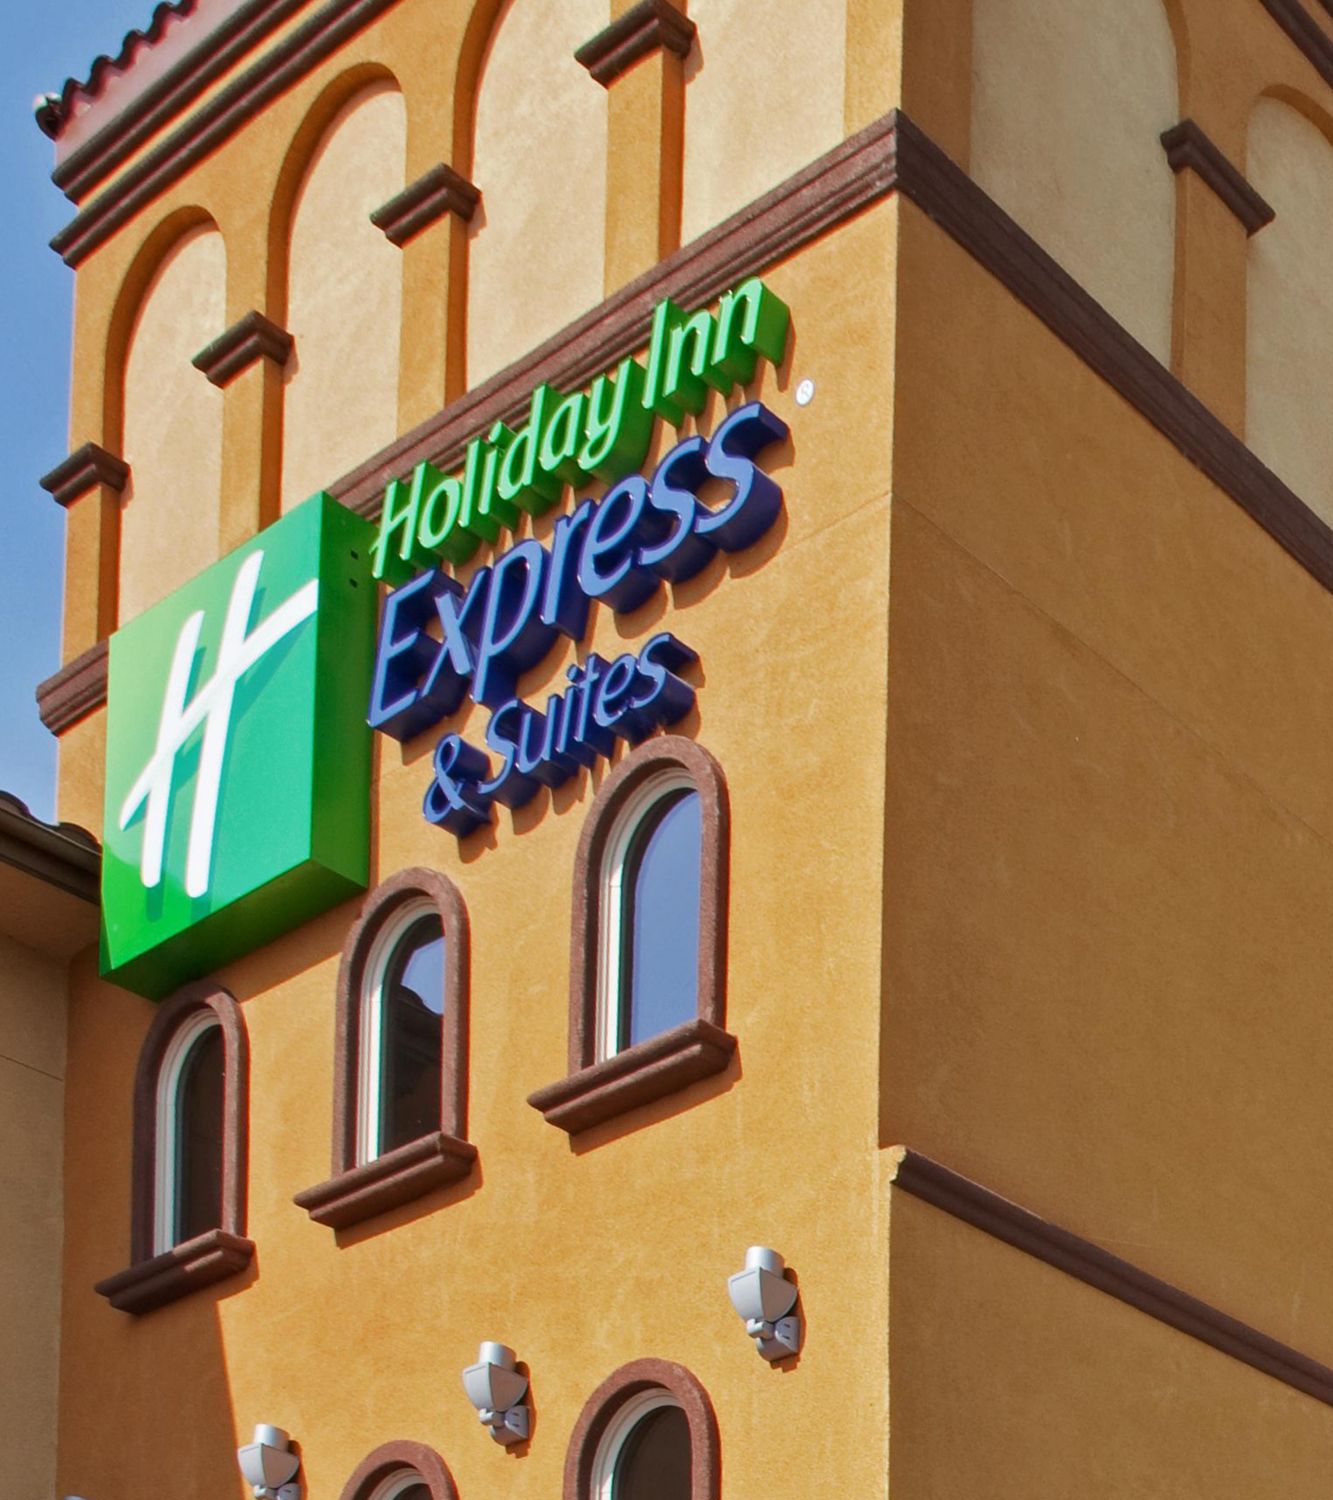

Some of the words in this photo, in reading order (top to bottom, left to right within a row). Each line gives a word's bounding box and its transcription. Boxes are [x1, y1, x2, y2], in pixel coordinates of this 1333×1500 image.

[365, 401, 787, 740] Express
[370, 356, 652, 580] Holiday
[642, 276, 790, 428] Inn
[424, 731, 492, 837] &
[478, 632, 700, 808] Suites
